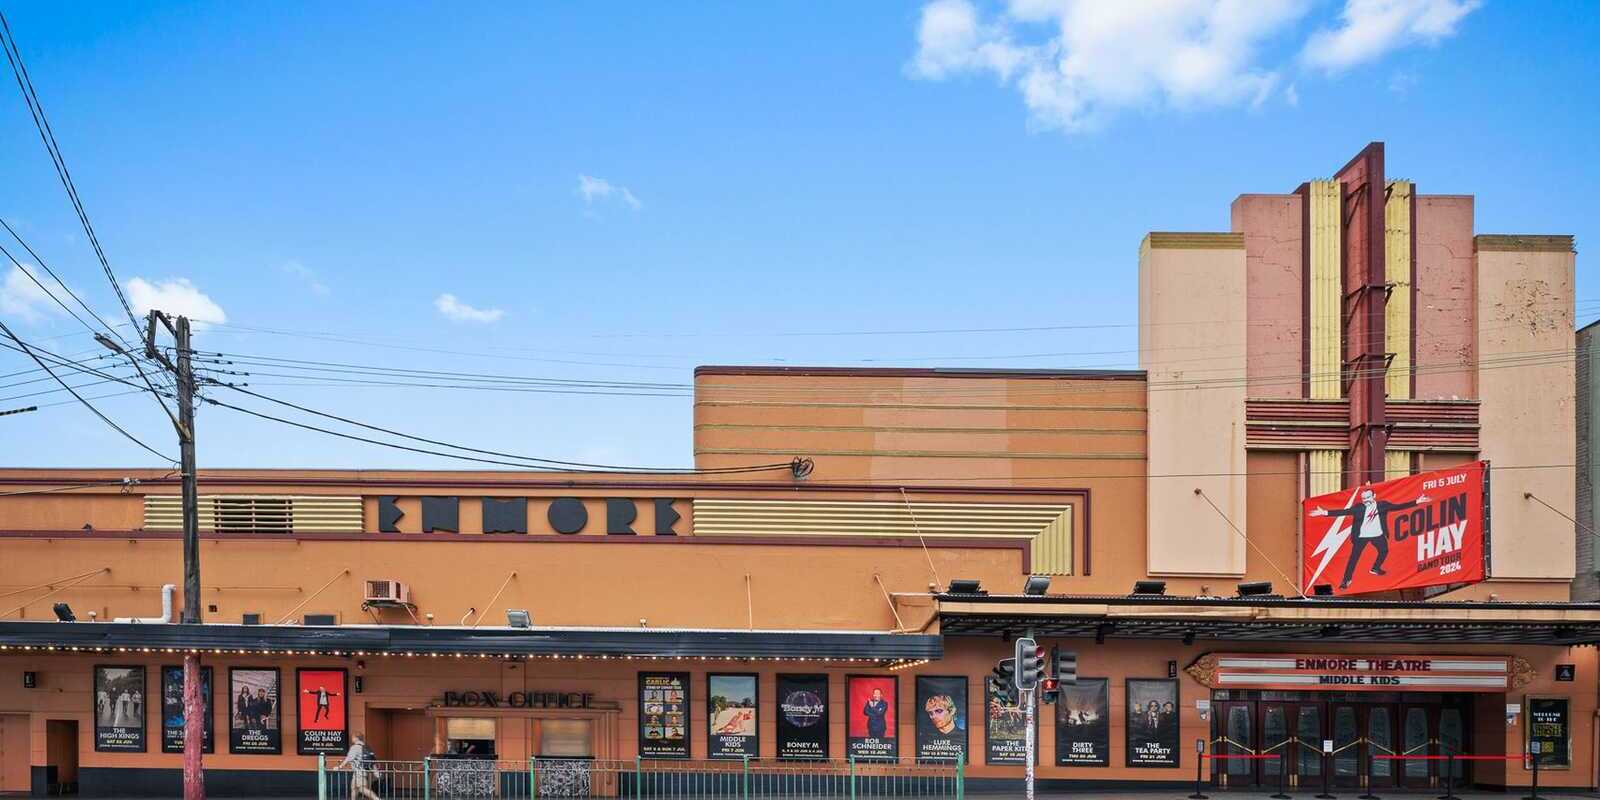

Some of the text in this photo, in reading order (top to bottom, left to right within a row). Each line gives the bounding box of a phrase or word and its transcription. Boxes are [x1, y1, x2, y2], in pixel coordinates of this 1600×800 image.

[1423, 473, 1468, 490] FRI 5 JULY
[378, 496, 681, 536] ENMORE
[1395, 493, 1467, 542] COLIN
[1417, 519, 1468, 562] HAY
[1417, 552, 1462, 572] BAND TOUR
[1440, 561, 1462, 576] 2024
[1295, 659, 1431, 672] ENMORE THEATRE
[1319, 675, 1400, 685] MIDDLE KIDS
[444, 691, 596, 709] BOX OFFICE
